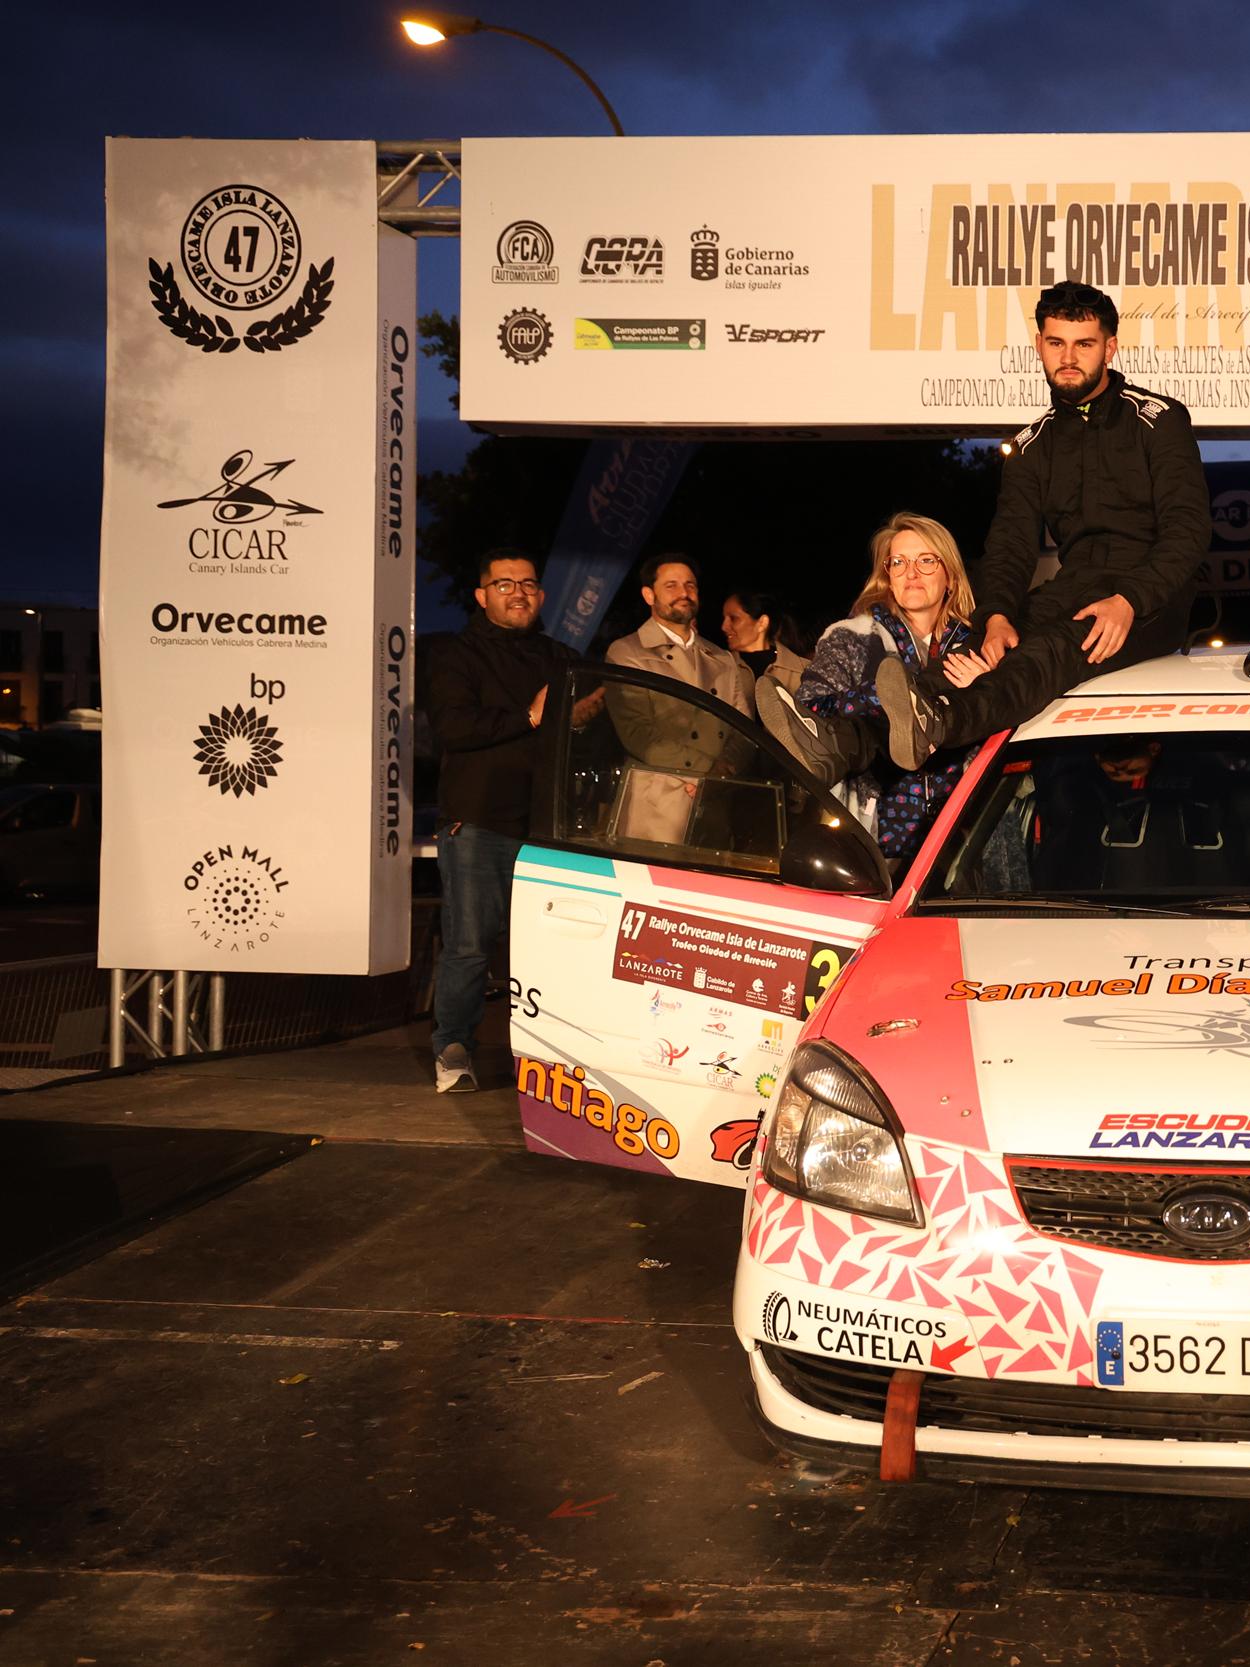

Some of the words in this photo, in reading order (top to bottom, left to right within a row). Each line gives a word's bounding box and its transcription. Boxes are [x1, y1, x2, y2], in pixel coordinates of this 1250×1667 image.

[211, 190, 258, 211] ISLA
[244, 198, 296, 304] LANZAROTE
[224, 226, 260, 273] 47
[512, 236, 541, 261] FCA
[725, 247, 794, 261] Gobierno
[952, 203, 1056, 287] RALLYE
[1065, 202, 1227, 287] ORVECAME
[495, 270, 556, 282] AUTOMOVILISMO
[725, 262, 743, 276] de
[745, 262, 809, 276] Canarias
[724, 279, 747, 290] islas
[748, 279, 782, 291] iguales
[1161, 302, 1181, 320] de
[613, 326, 666, 335] Campeonato
[667, 326, 679, 335] BP
[1161, 352, 1171, 374] de
[1173, 345, 1224, 374] RALLYES
[1226, 352, 1235, 374] de
[920, 378, 1006, 407] CAMPEONATO
[1007, 382, 1017, 407] de
[1018, 378, 1053, 407] RALL
[1173, 378, 1222, 408] PALMAS
[1222, 391, 1229, 408] e
[388, 325, 410, 559] Orvecame
[189, 528, 289, 560] CICAR
[189, 562, 227, 576] Canary
[230, 562, 267, 575] Islands
[270, 563, 290, 575] Car
[151, 602, 328, 636] Orvecame
[150, 636, 209, 648] Organización
[211, 637, 254, 647] Vehículos
[256, 638, 293, 648] Cabrera
[295, 639, 328, 649] Medina
[250, 672, 286, 705] bp
[387, 625, 407, 857] Orvecame
[184, 844, 234, 891] OPEN
[241, 845, 289, 893] MALL
[187, 908, 286, 952] LANZAROTE
[620, 908, 647, 941] 47
[648, 915, 678, 935] Rallye
[678, 921, 726, 945] Orvecame
[726, 931, 744, 947] Isla
[744, 935, 757, 951] de
[758, 938, 807, 961] Lanzarote
[671, 937, 698, 953] Trofeo
[699, 943, 731, 960] Ciudad
[731, 949, 743, 961] de
[743, 951, 778, 969] Arrecife
[619, 958, 683, 981] LANZAROTE
[706, 976, 727, 988] Cabildo
[705, 982, 733, 995] Lanzarote
[944, 972, 1152, 1003] Samuel
[706, 1072, 734, 1089] CICAR
[517, 1056, 680, 1160] ntiago
[797, 1300, 947, 1338] NEUMÁTICOS
[817, 1325, 924, 1366] CATELA
[1128, 1334, 1227, 1375] 3562
[1105, 1360, 1116, 1376] E
